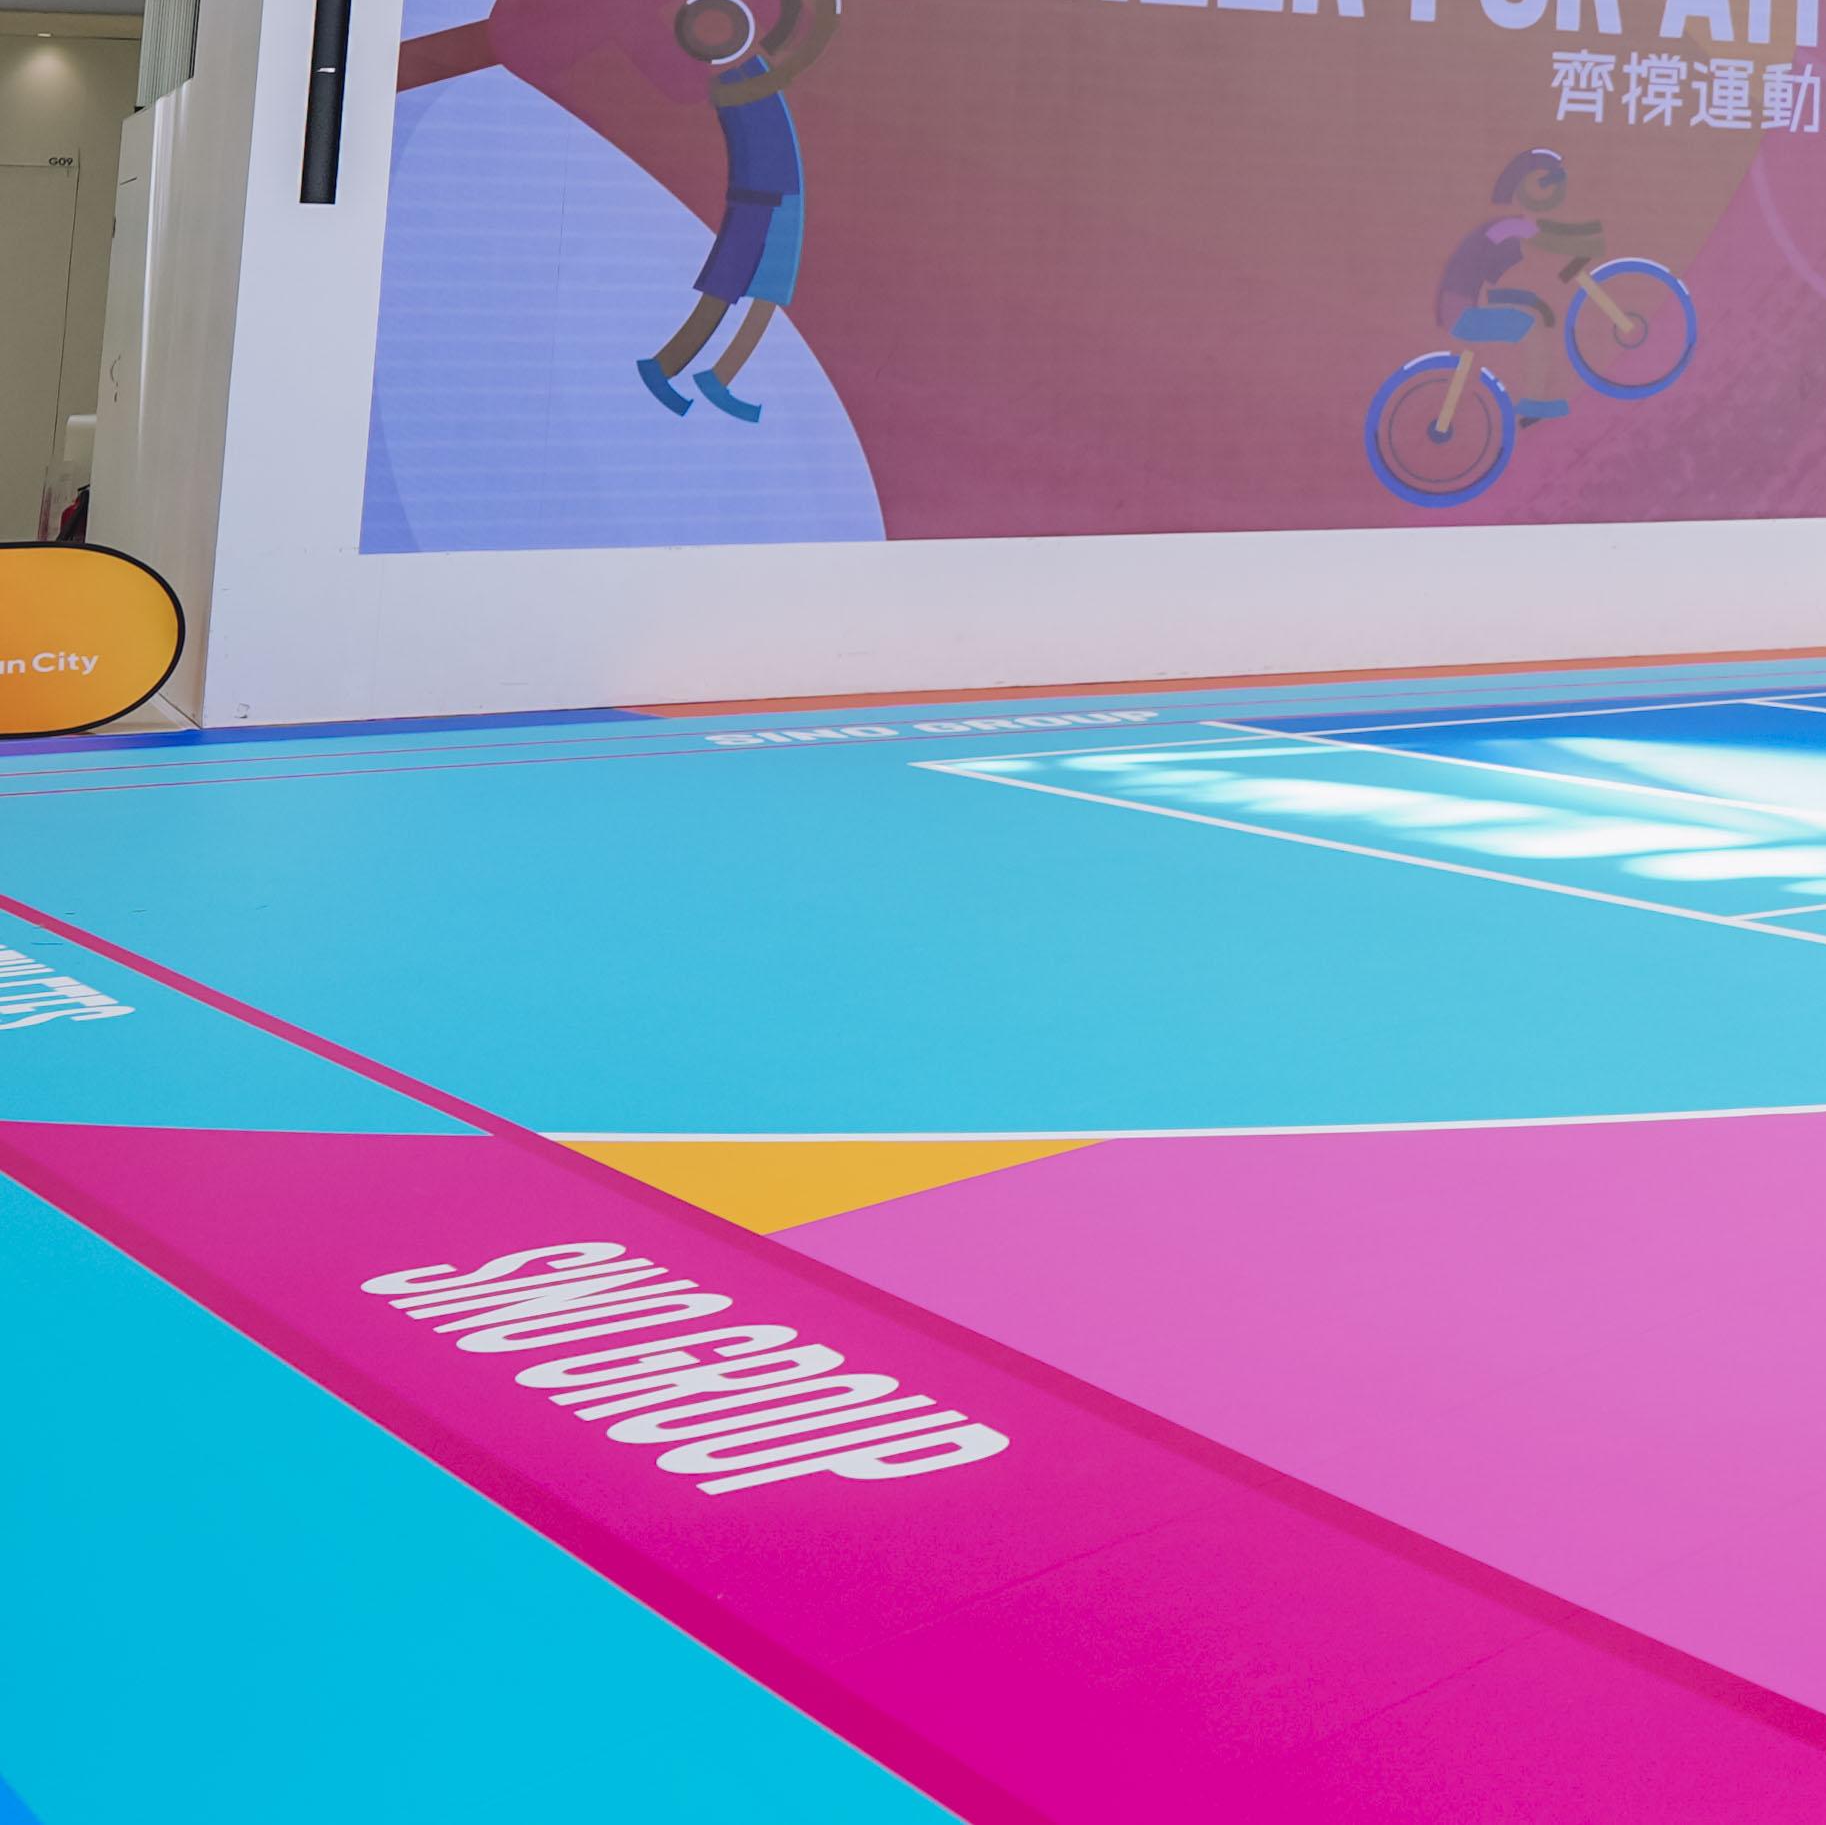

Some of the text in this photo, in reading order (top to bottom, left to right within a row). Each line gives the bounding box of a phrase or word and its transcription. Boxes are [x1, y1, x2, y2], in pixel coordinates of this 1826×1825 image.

[33, 651, 98, 676] City
[704, 710, 1160, 746] SINO GROUP
[360, 1241, 1010, 1496] SINO GROUP
